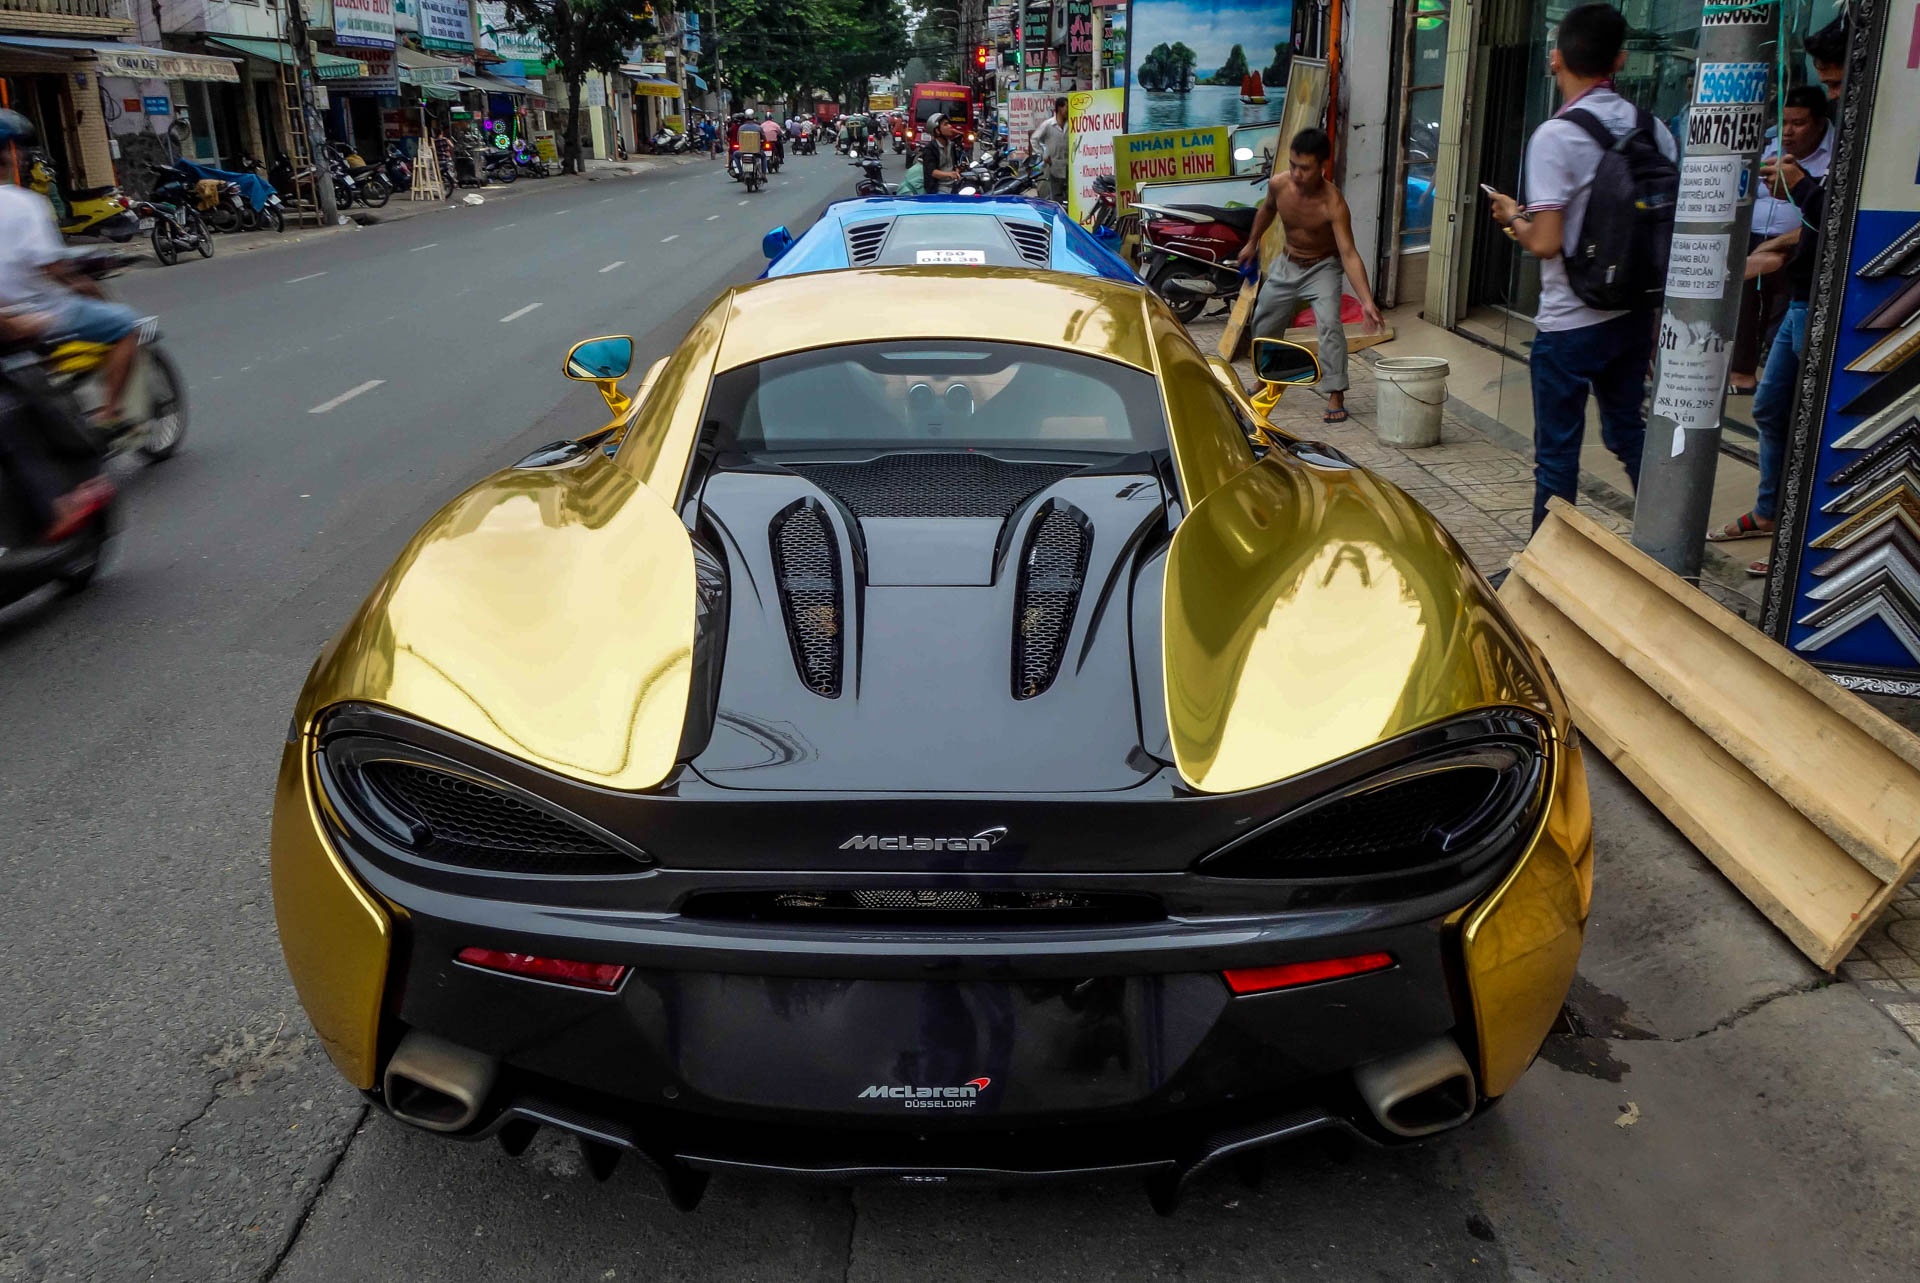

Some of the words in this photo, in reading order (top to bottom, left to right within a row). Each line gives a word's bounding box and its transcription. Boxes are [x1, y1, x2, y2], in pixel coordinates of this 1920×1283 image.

[1073, 96, 1090, 106] 247
[1071, 109, 1100, 133] XƯỞNG
[1130, 137, 1174, 154] NHẬN
[1130, 157, 1176, 181] KHUNG
[1183, 151, 1214, 175] HÌNH
[1722, 163, 1733, 176] HỘ
[1718, 203, 1730, 212] 257
[1710, 241, 1721, 252] HỘ
[1694, 280, 1704, 289] 121
[1707, 281, 1720, 289] 257
[839, 835, 990, 851] McLaren
[858, 1085, 976, 1098] McLaren
[905, 1099, 976, 1108] DÜSSELDORF
